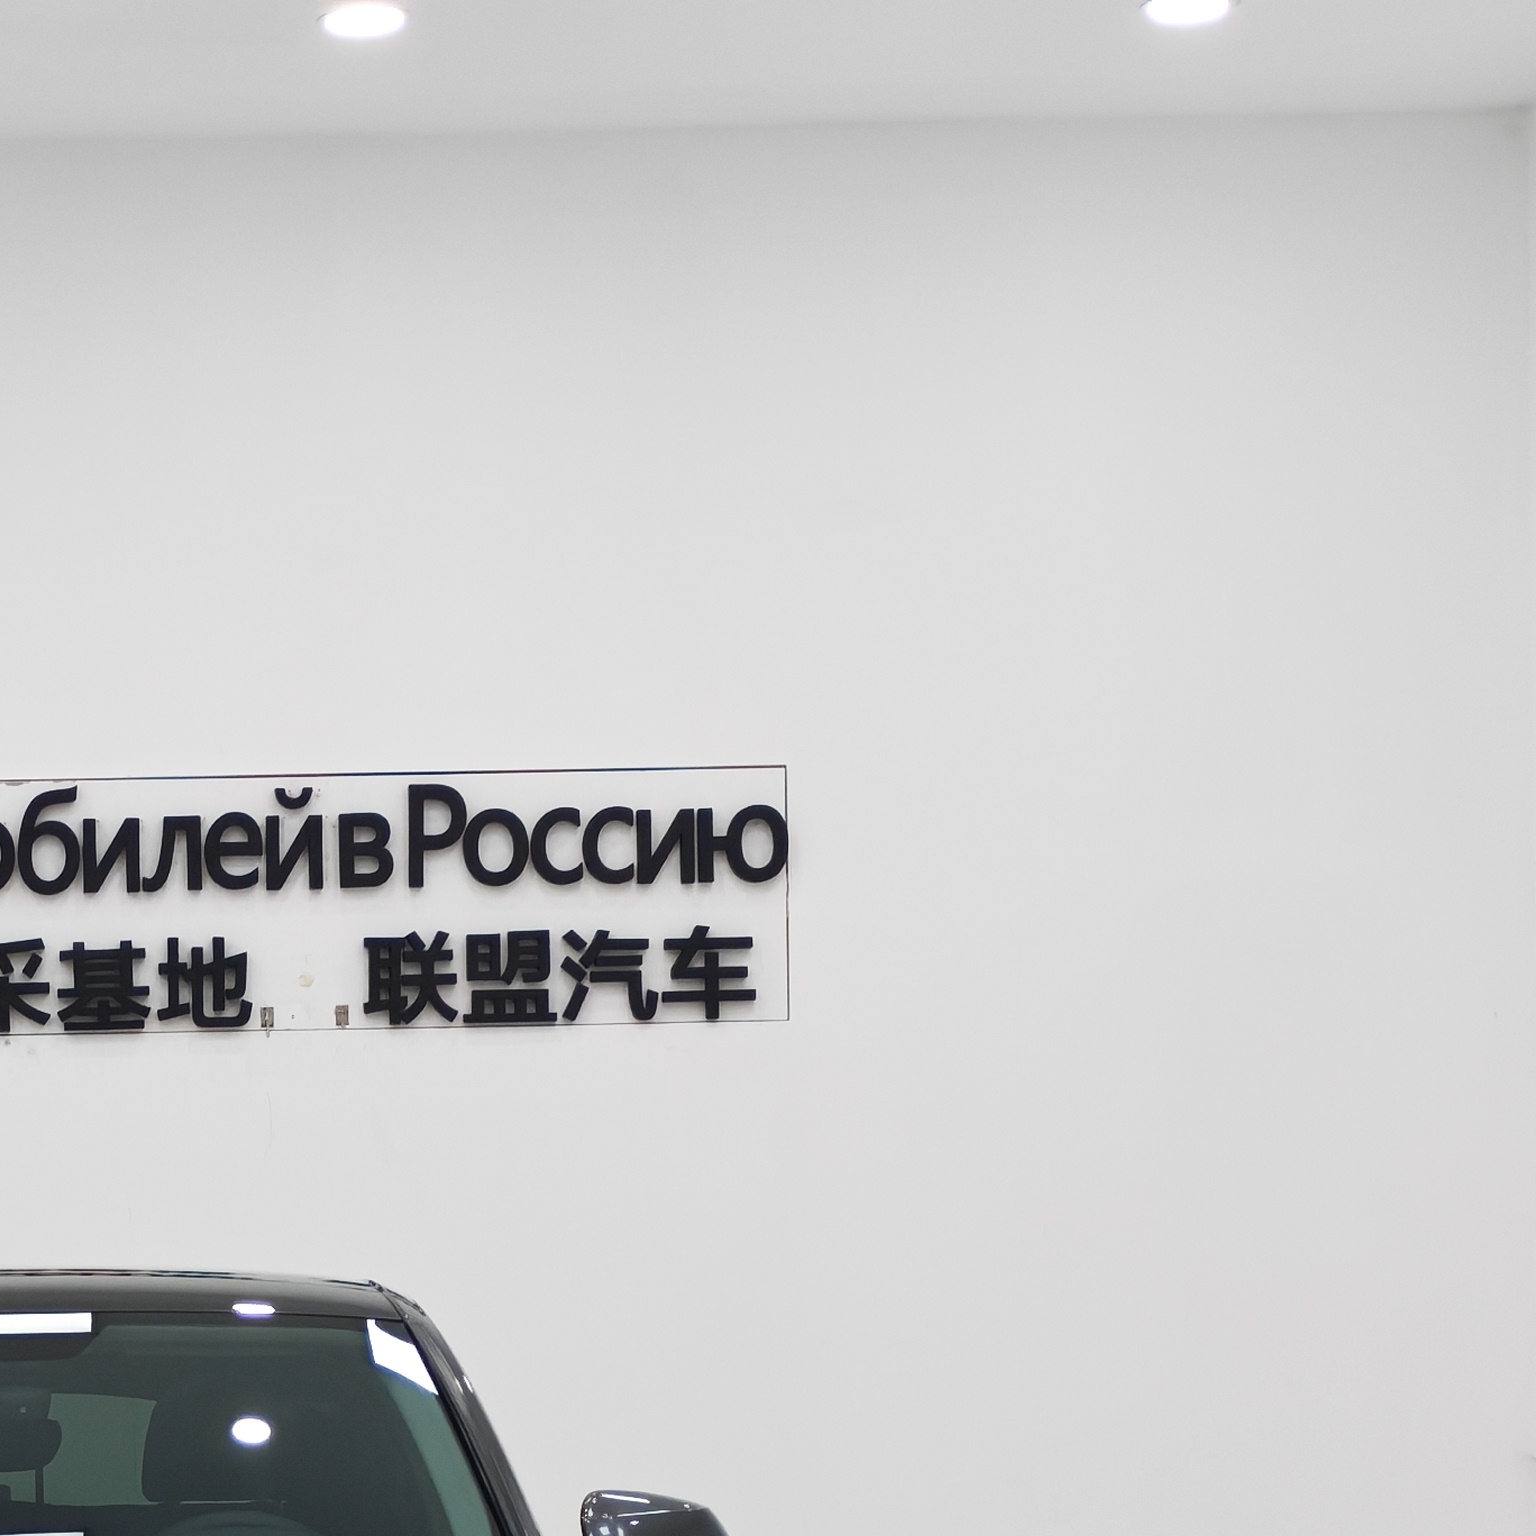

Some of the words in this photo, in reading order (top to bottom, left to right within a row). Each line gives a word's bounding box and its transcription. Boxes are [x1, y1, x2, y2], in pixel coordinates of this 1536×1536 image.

[338, 811, 394, 890] в
[407, 783, 790, 889] Россию
[362, 924, 757, 1026] 联盟汽车
